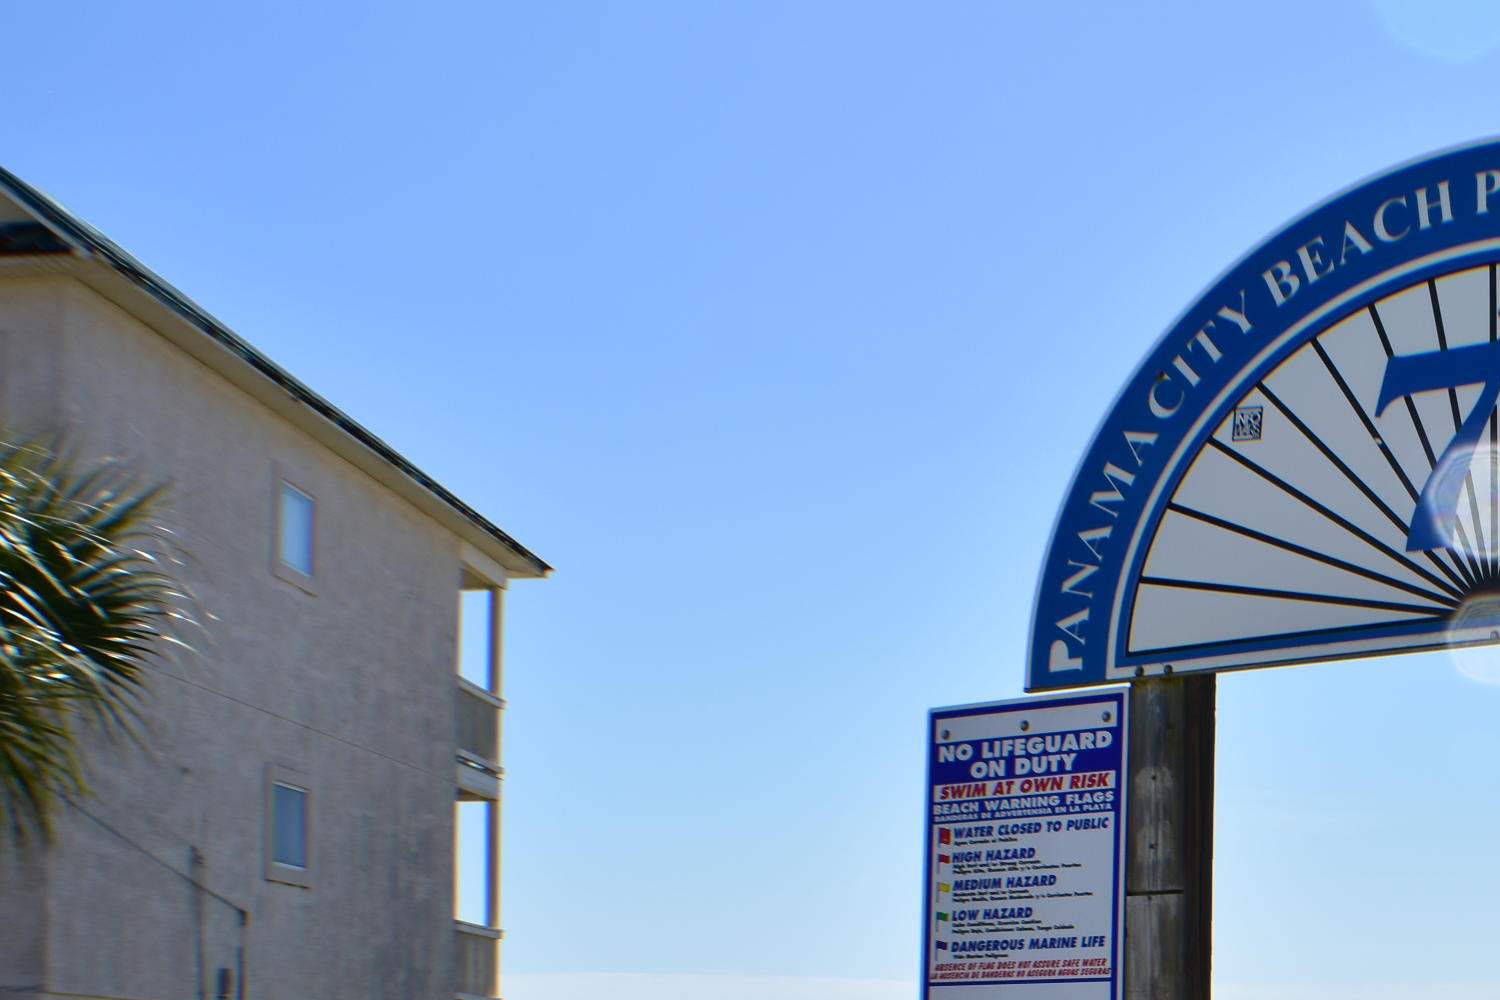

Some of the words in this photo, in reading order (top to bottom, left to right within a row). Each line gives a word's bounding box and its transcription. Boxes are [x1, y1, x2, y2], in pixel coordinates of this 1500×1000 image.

[1048, 430, 1159, 673] PANAMA
[1148, 289, 1253, 420] CITY
[1261, 179, 1458, 308] BEACH
[938, 744, 973, 762] NO
[982, 731, 1112, 758] LIFEGUARD
[970, 760, 1006, 779] ON
[1015, 753, 1078, 775] DUTY
[940, 783, 986, 799] SWIM
[993, 781, 1015, 794] AT
[1020, 777, 1063, 790] OWN
[1070, 772, 1110, 785] RISK
[933, 802, 979, 815] BEACH
[984, 796, 1060, 811] WARNING
[1066, 791, 1114, 804] FLAGS
[954, 826, 993, 839] WATER
[998, 822, 1042, 836] CLOSED
[1047, 821, 1062, 832] TO
[1067, 818, 1109, 831] PUBLIC
[952, 851, 981, 863] HIGH
[986, 848, 1036, 860] HAZARD
[953, 878, 1001, 891] MEDIUM
[1007, 875, 1057, 888] HAZARD
[952, 910, 979, 921] LOW
[983, 907, 1033, 919] HAZARD
[952, 939, 1024, 952] DANGEROUS
[1029, 937, 1077, 949] MARINE
[1081, 936, 1106, 948] LIFE
